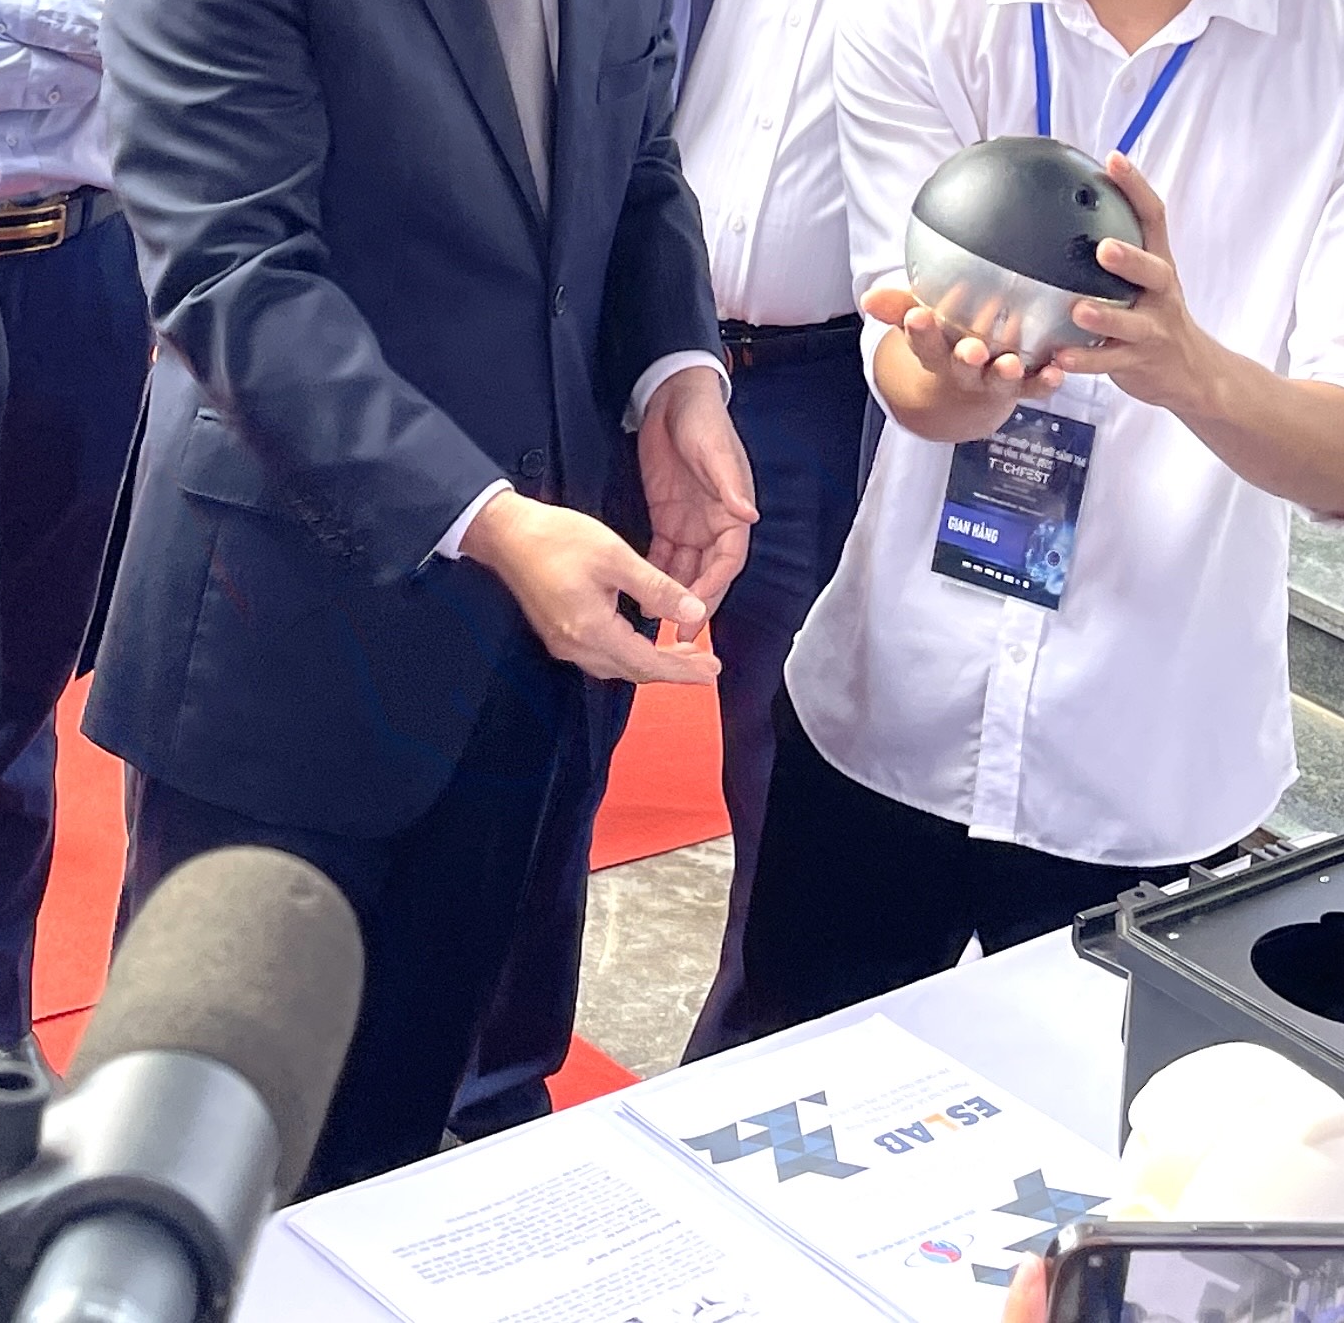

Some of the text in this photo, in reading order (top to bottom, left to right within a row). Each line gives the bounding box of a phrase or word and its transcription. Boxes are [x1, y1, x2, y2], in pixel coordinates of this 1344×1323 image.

[989, 457, 1051, 484] TECHFEST
[947, 516, 971, 535] GIAN
[873, 1095, 1003, 1155] ESLAB
